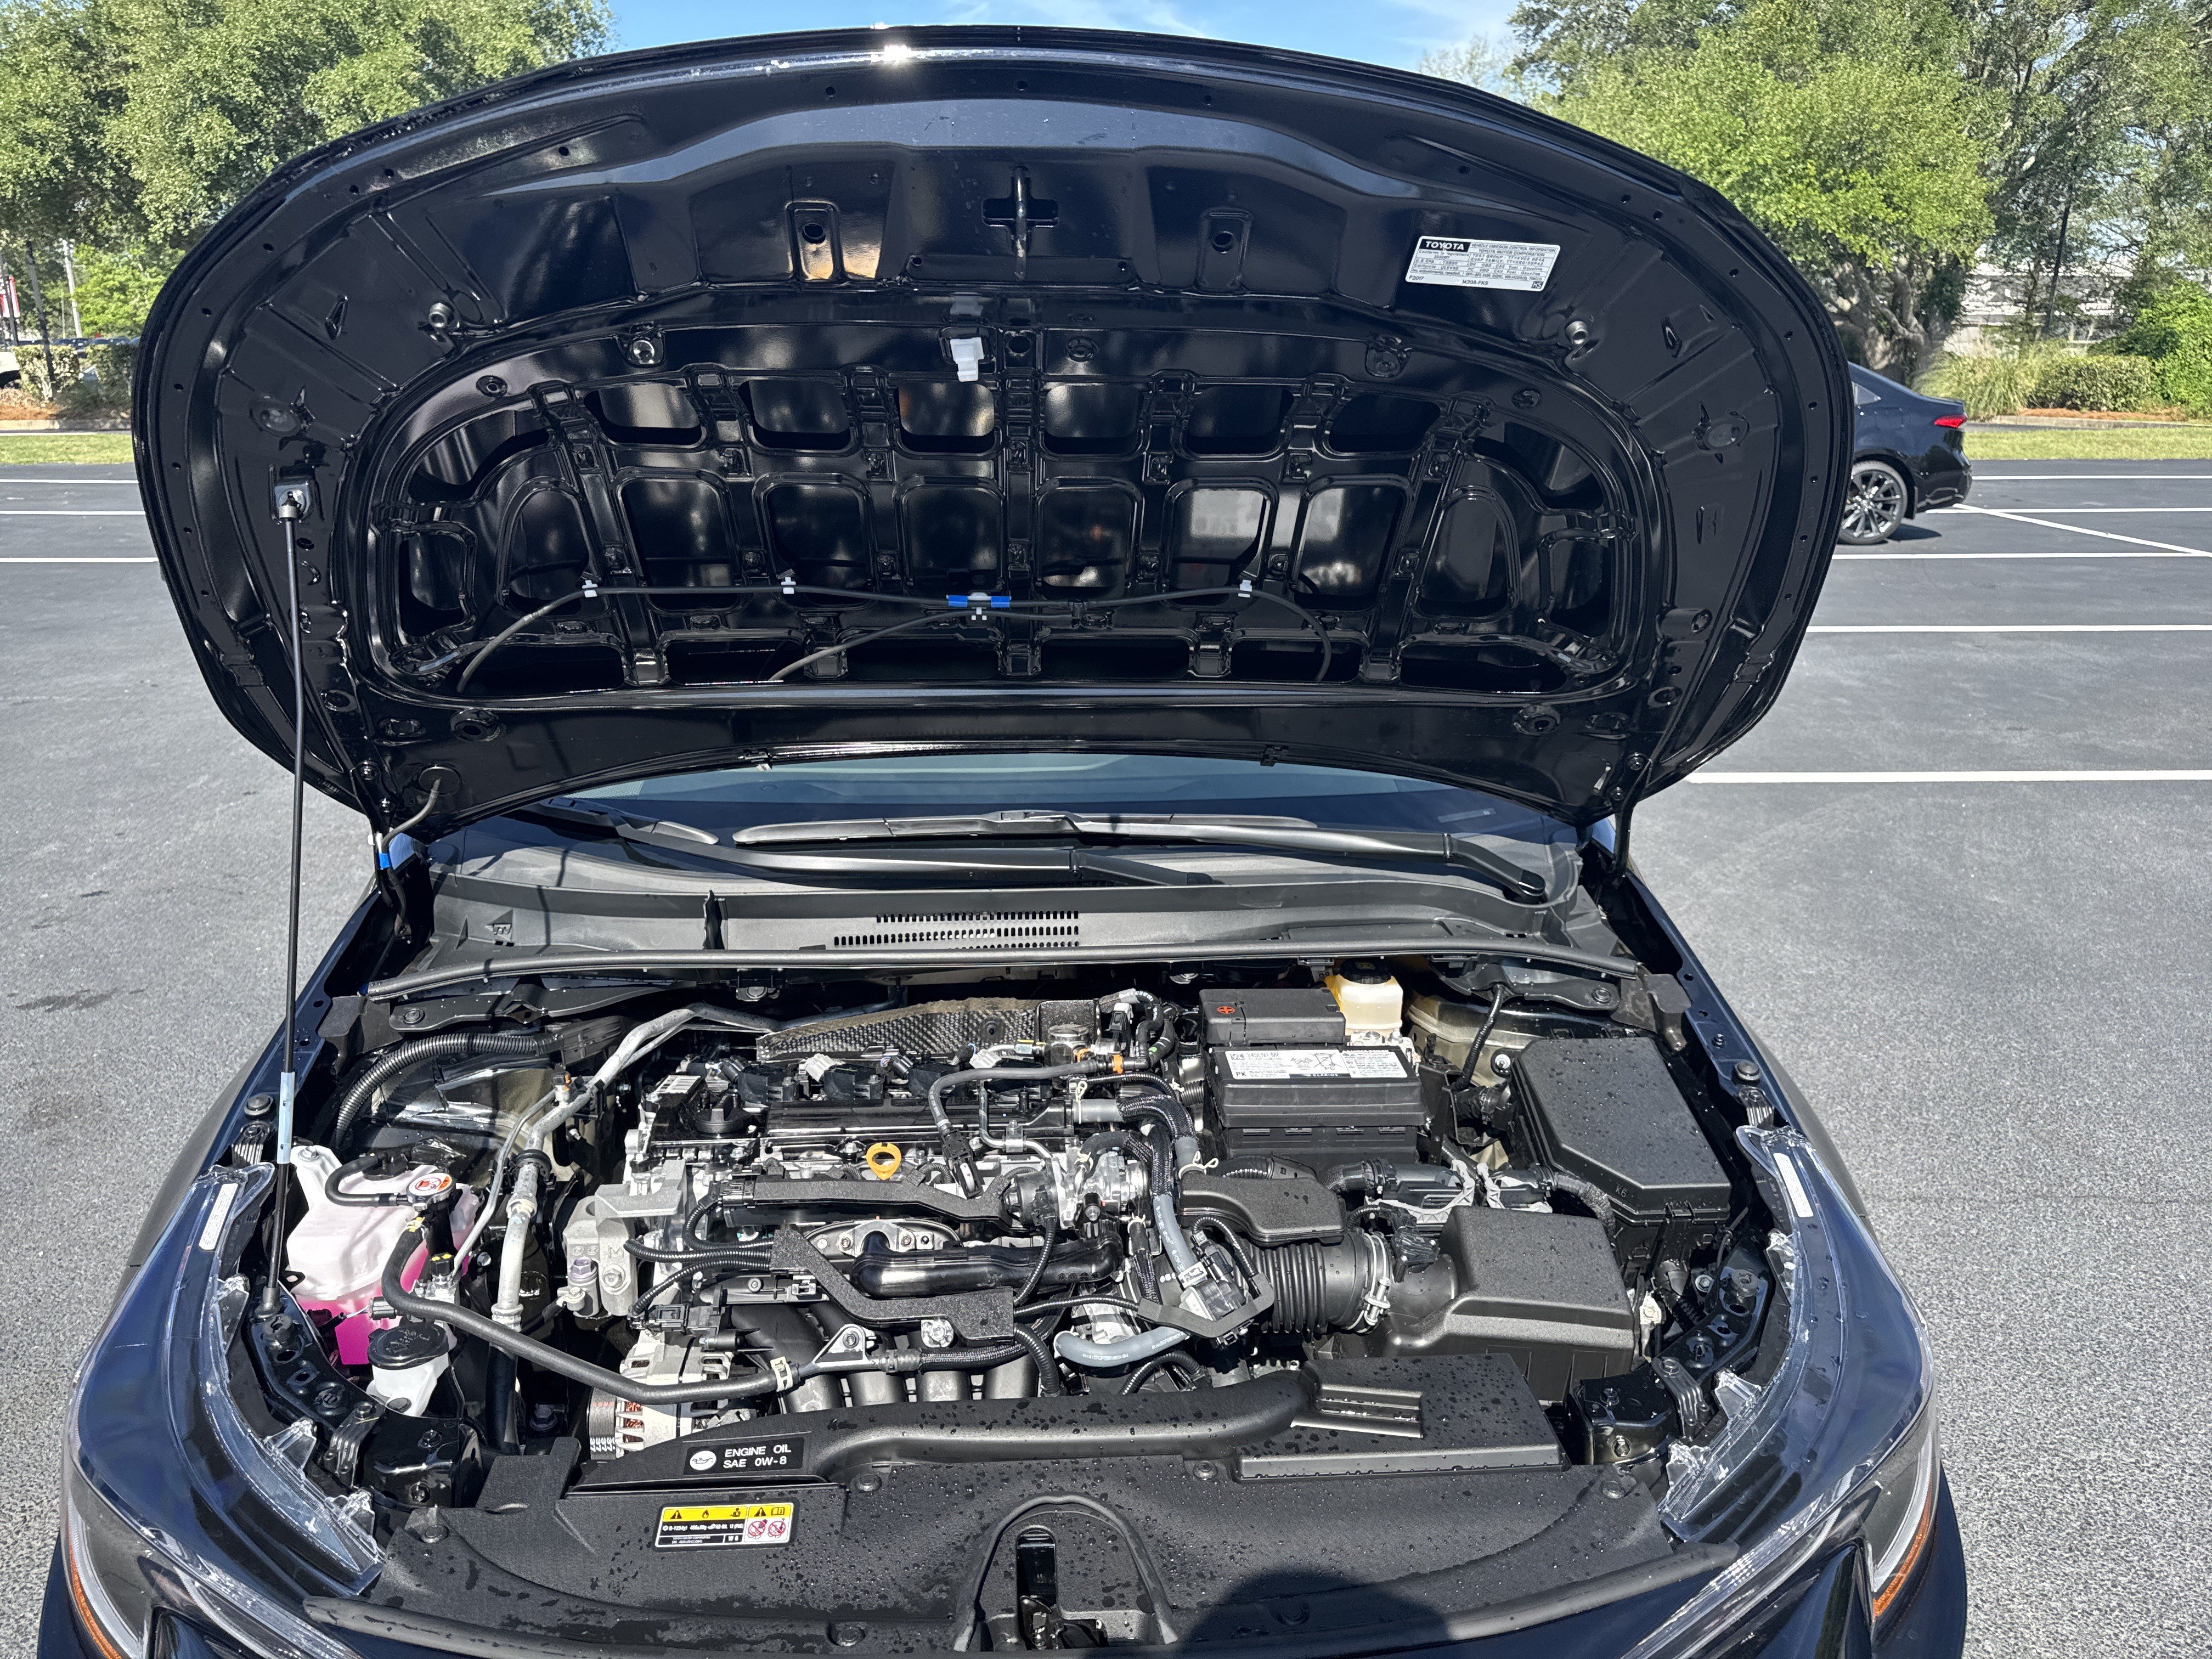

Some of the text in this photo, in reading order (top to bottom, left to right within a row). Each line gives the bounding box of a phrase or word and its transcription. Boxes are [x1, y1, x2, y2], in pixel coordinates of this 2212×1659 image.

[1426, 241, 1464, 250] TOYOTA
[1615, 1185, 1628, 1198] K6
[725, 1444, 792, 1458] ENGINE OIL
[723, 1455, 787, 1468] SAE 0W-8
